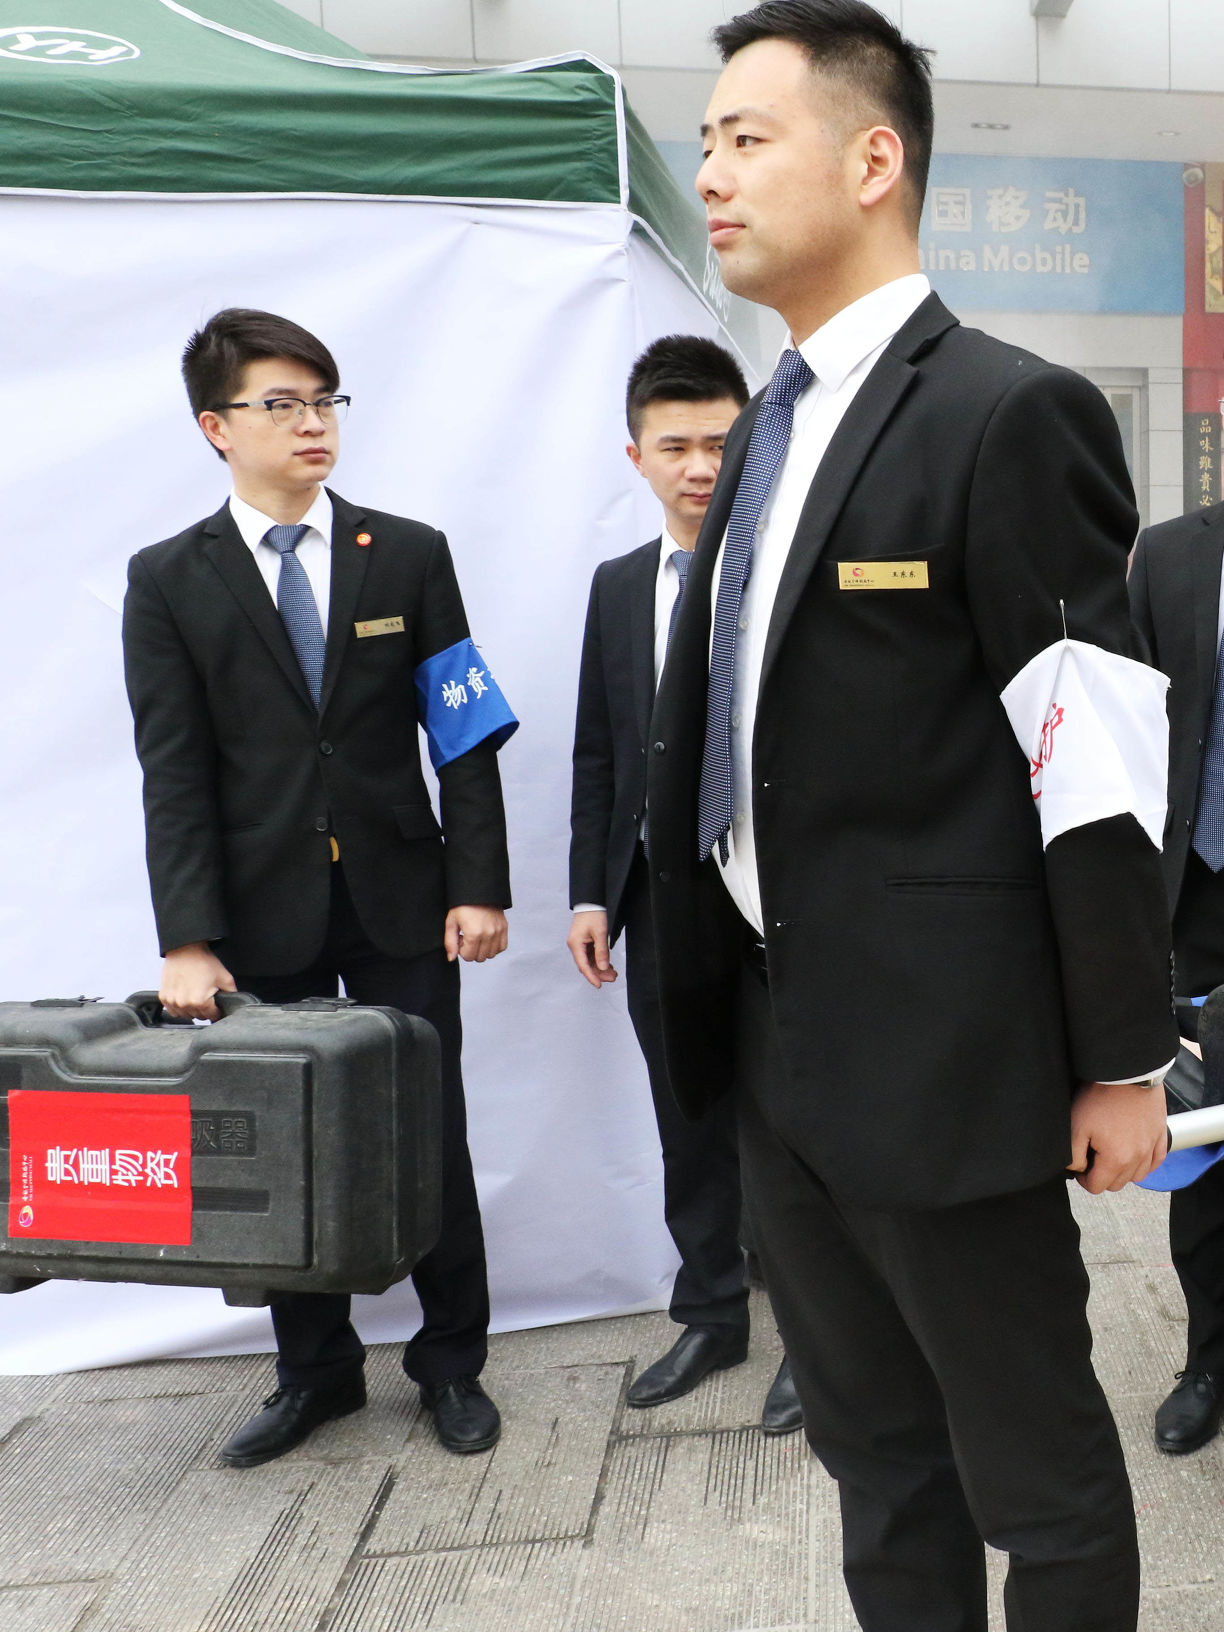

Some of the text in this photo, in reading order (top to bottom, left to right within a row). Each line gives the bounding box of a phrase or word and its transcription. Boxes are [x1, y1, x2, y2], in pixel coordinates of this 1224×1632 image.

[930, 185, 1087, 235] 国移动
[982, 243, 1090, 274] Mobile
[441, 667, 489, 710] 物资
[45, 1145, 179, 1188] 贵重物资
